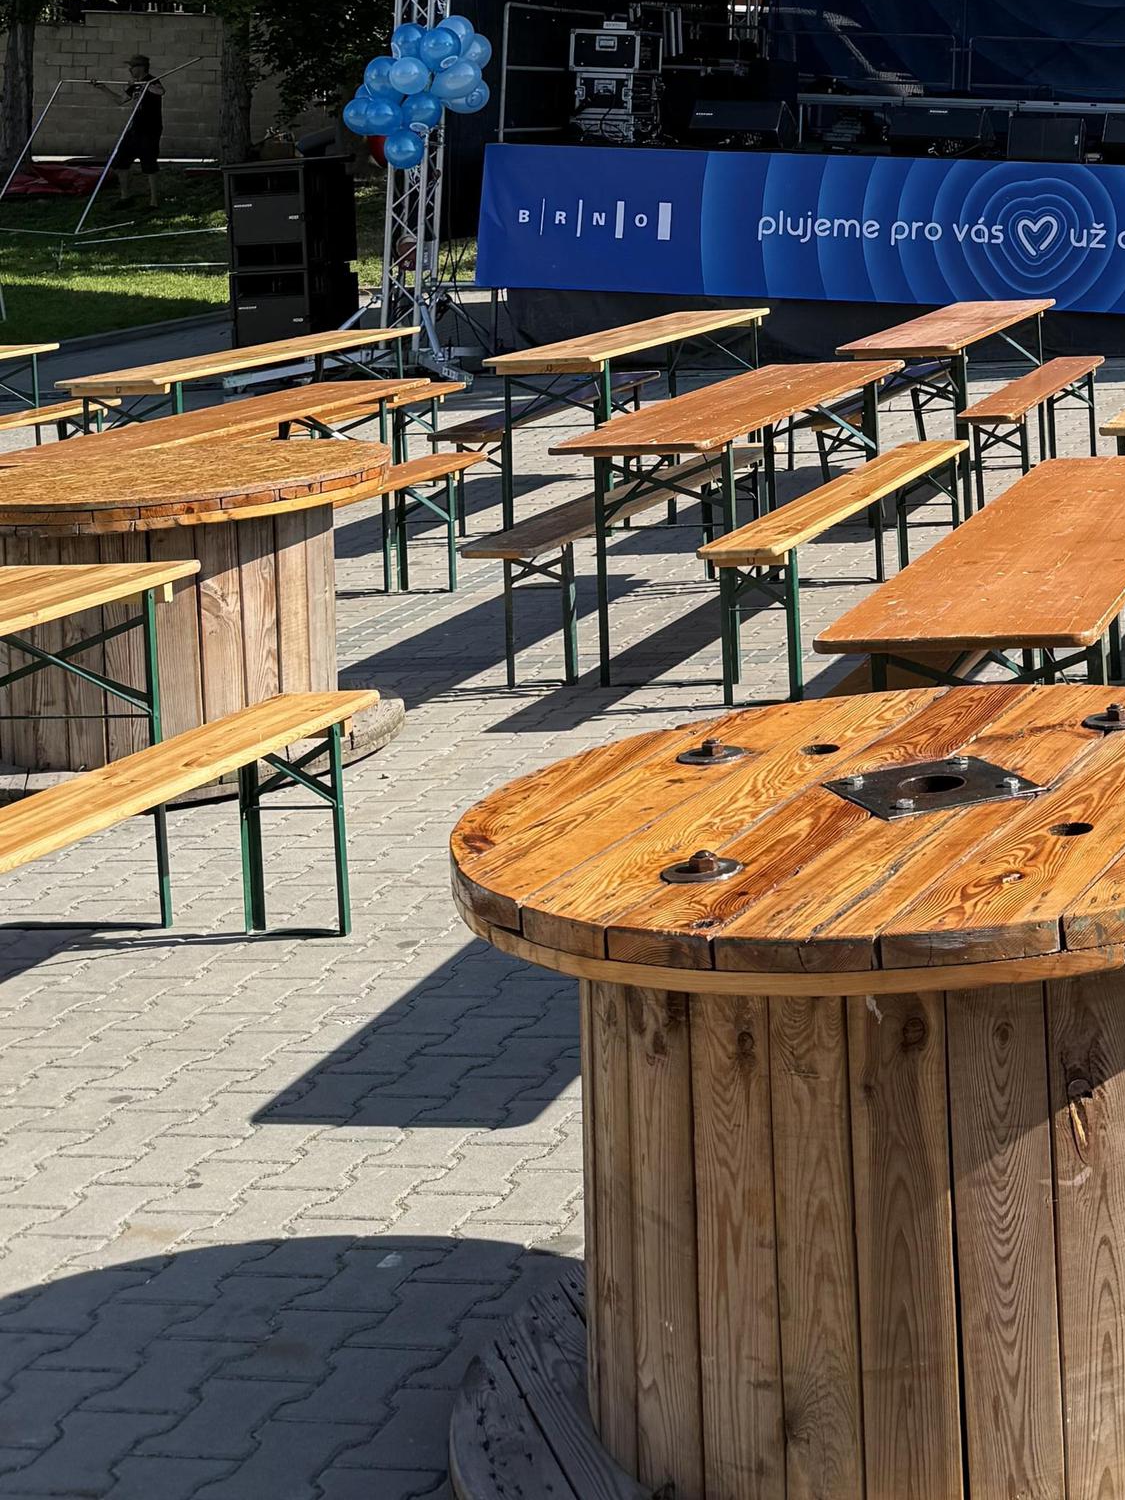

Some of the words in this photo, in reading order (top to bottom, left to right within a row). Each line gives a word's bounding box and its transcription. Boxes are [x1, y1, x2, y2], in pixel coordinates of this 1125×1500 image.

[757, 210, 880, 243] plujeme
[890, 220, 943, 246] pro
[952, 216, 1004, 244] vás
[1069, 221, 1107, 249] už
